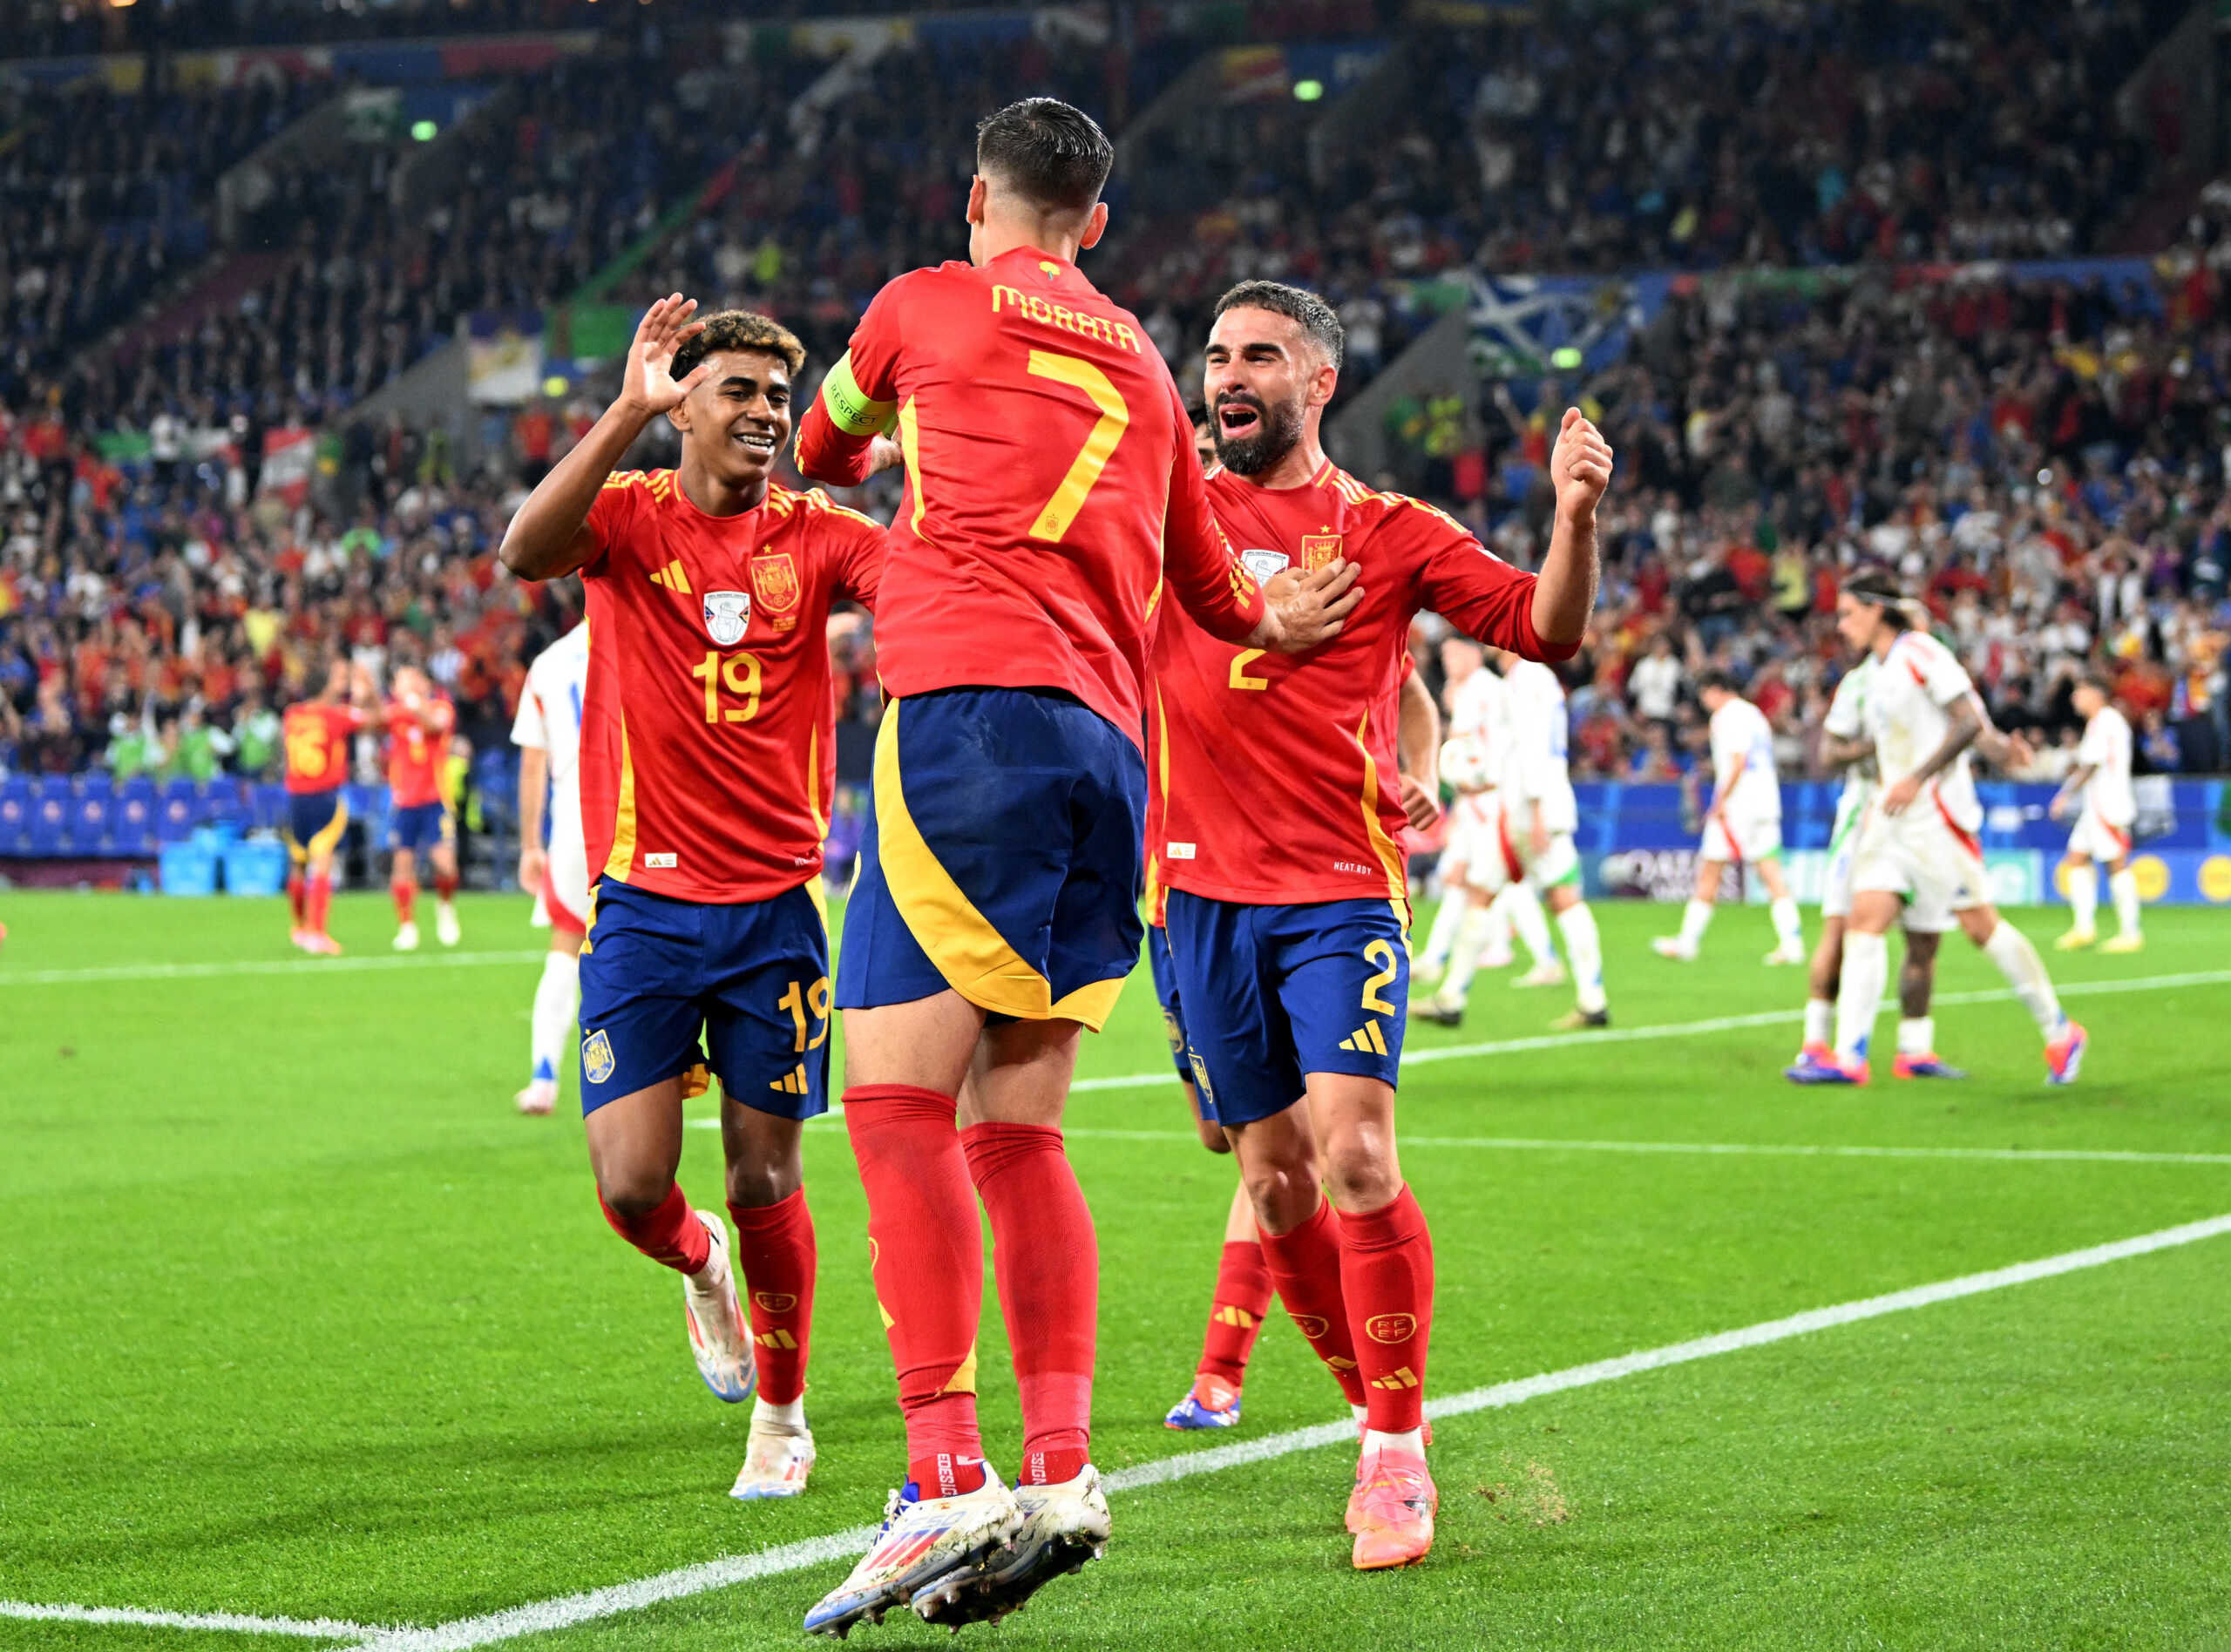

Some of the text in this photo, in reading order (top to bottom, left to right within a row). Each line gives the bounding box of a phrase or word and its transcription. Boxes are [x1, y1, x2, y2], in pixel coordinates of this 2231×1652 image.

[992, 284, 1142, 354] MORATA
[831, 383, 877, 425] RESPECT
[1027, 349, 1129, 543] 7
[693, 651, 762, 723] 19
[1333, 861, 1372, 876] HEAT.RDY
[1361, 938, 1397, 1016] 2
[778, 977, 830, 1053] 19
[938, 1453, 958, 1498] EDESIG
